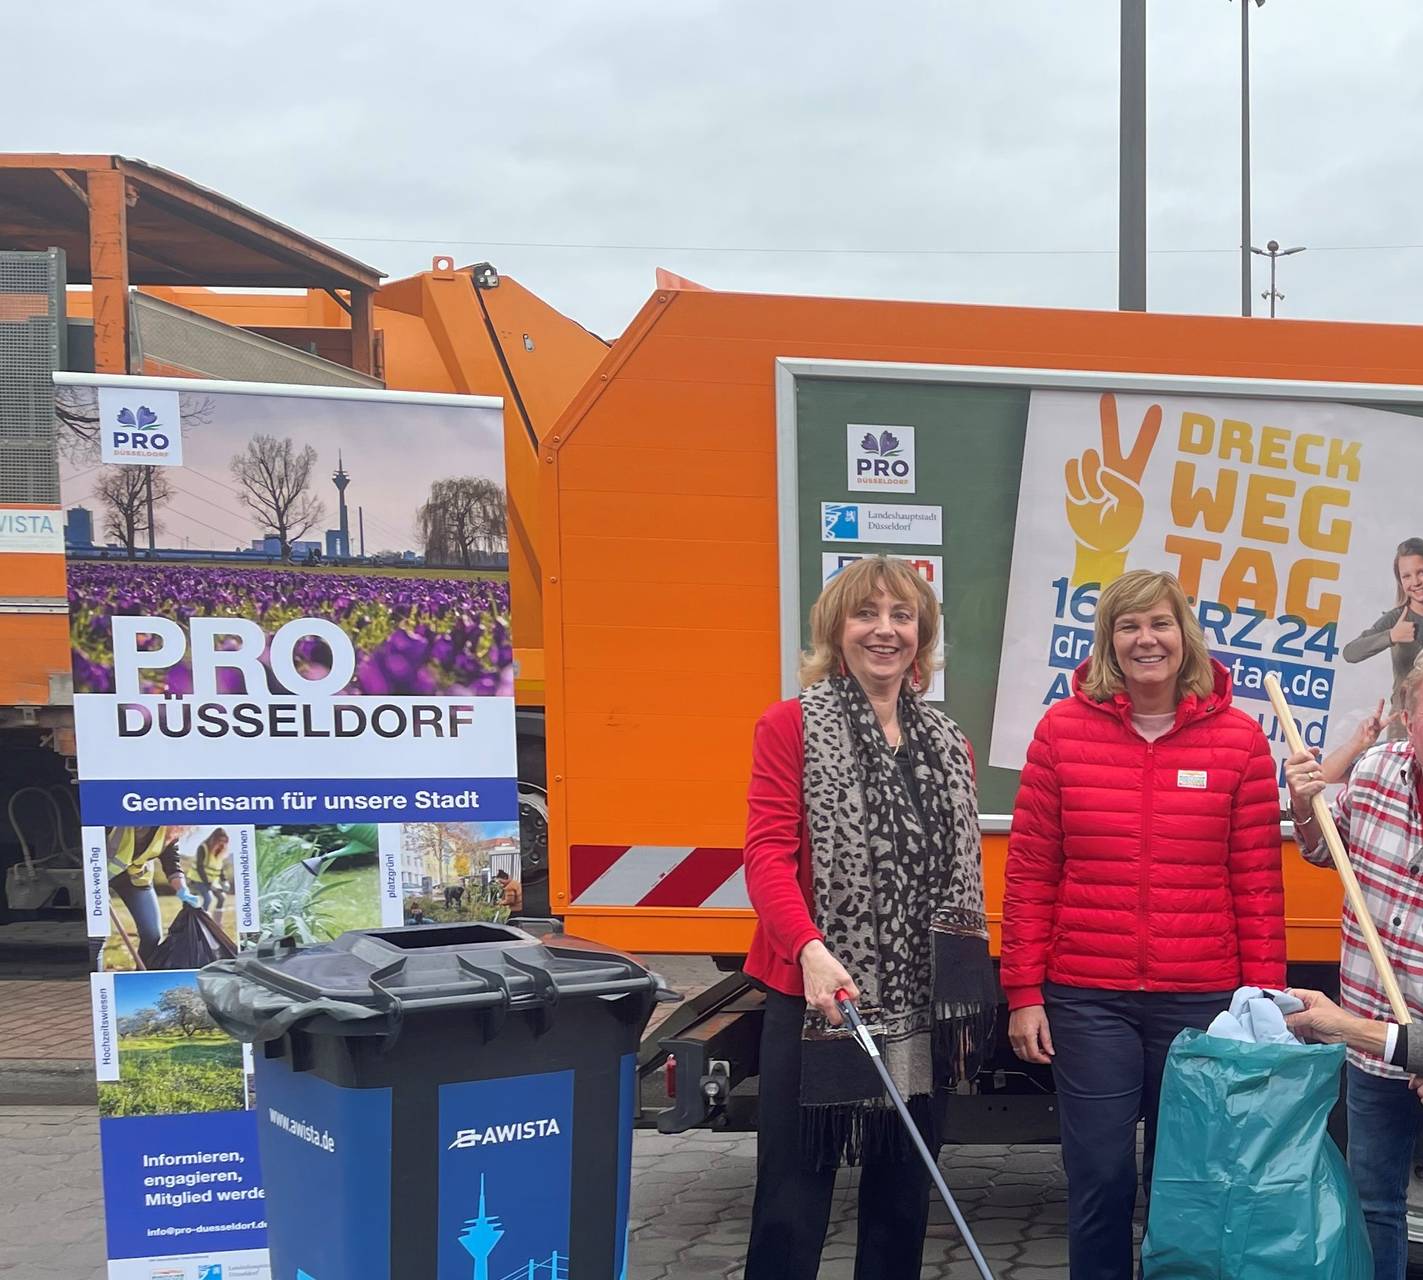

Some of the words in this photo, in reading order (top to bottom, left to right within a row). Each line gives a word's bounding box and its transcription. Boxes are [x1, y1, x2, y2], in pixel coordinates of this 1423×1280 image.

[113, 432, 169, 450] PRO
[1178, 411, 1362, 482] DRECK
[857, 458, 909, 477] PRO
[868, 510, 936, 522] Landeshauptstadt
[1171, 461, 1352, 554] WEG
[0, 515, 54, 533] ISTA
[868, 521, 911, 531] Düsseldorf
[1165, 535, 1342, 628] TAG
[1272, 614, 1339, 662] 24
[111, 615, 356, 697] PRO
[117, 690, 474, 738] DÜSSELDORF
[122, 793, 274, 812] Gemeinsam
[281, 793, 317, 810] für
[324, 795, 408, 810] unsere
[415, 790, 480, 809] Stadt
[92, 847, 102, 916] Dreck-weg-Tag
[100, 988, 110, 1065] Hochzeitswiesen
[269, 1107, 335, 1153] www.awista.de
[481, 1118, 560, 1145] AWISTA
[143, 1151, 245, 1167] Informieren,
[144, 1171, 243, 1188] engagieren,
[145, 1189, 212, 1207] Mitglied
[217, 1187, 265, 1201] werde
